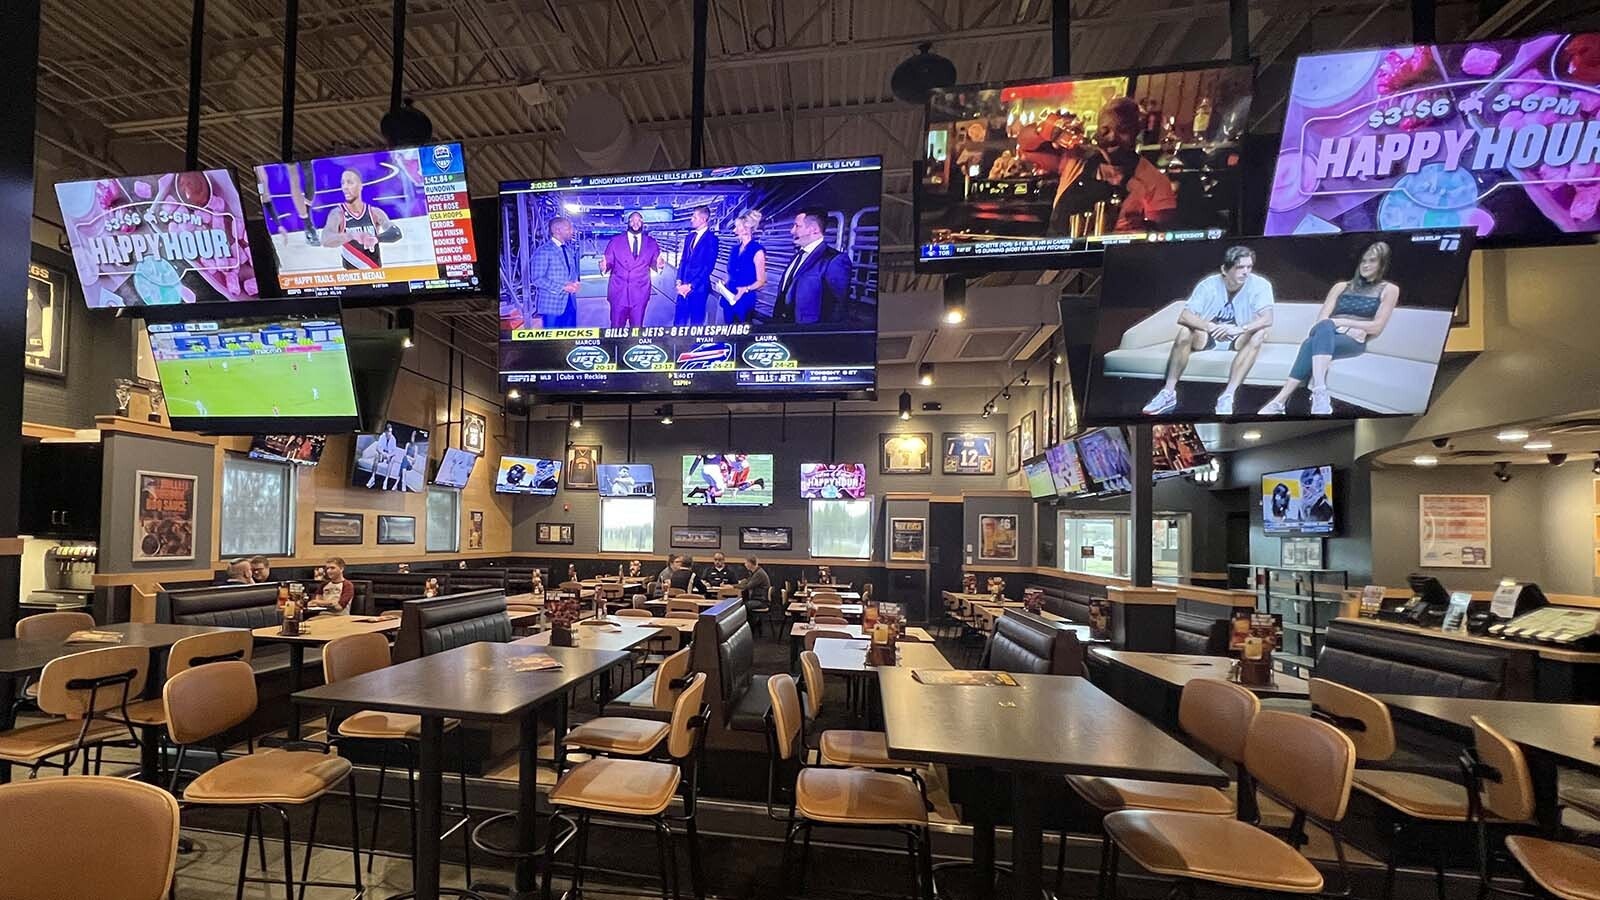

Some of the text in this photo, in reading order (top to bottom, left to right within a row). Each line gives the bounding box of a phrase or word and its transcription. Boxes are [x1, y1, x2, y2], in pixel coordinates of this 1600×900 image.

[1492, 94, 1580, 116] 3-6PM
[1317, 120, 1600, 178] HAPPY HOUR
[530, 181, 558, 190] 3:02:01
[590, 176, 614, 186] MONDAY
[614, 176, 632, 184] NIGHT
[426, 184, 456, 193] RUNDOWN
[426, 194, 456, 203] DODGERS
[428, 202, 460, 212] PETE ROSE
[430, 210, 464, 220] USA HOOPS
[105, 210, 202, 232] $3-$6 3-6PM
[431, 221, 455, 229] ERRORS
[444, 228, 464, 236] FINISH
[434, 238, 456, 246] ROOKIE
[89, 228, 232, 266] HAPPY HOUR
[436, 246, 464, 255] BRONCOS
[436, 254, 472, 264] NEAR NO-NO
[28, 264, 50, 278] GS
[294, 270, 385, 284] HAPPY TRAILS, BRONZE MEDAL!
[518, 330, 593, 339] GAME PICKS
[604, 327, 629, 338] BILLS
[642, 327, 664, 337] JETS
[670, 326, 678, 336] 8
[678, 326, 690, 336] ET
[690, 326, 704, 336] ON
[704, 324, 750, 336] ESPN/ABC
[572, 355, 604, 363] JETS
[628, 354, 662, 362] JETS
[748, 352, 784, 360] JETS
[25, 356, 44, 368] LL
[755, 374, 773, 382] BILLS
[778, 374, 796, 382] JETS
[960, 450, 978, 466] 12
[808, 478, 858, 486] HAPPY HOUR
